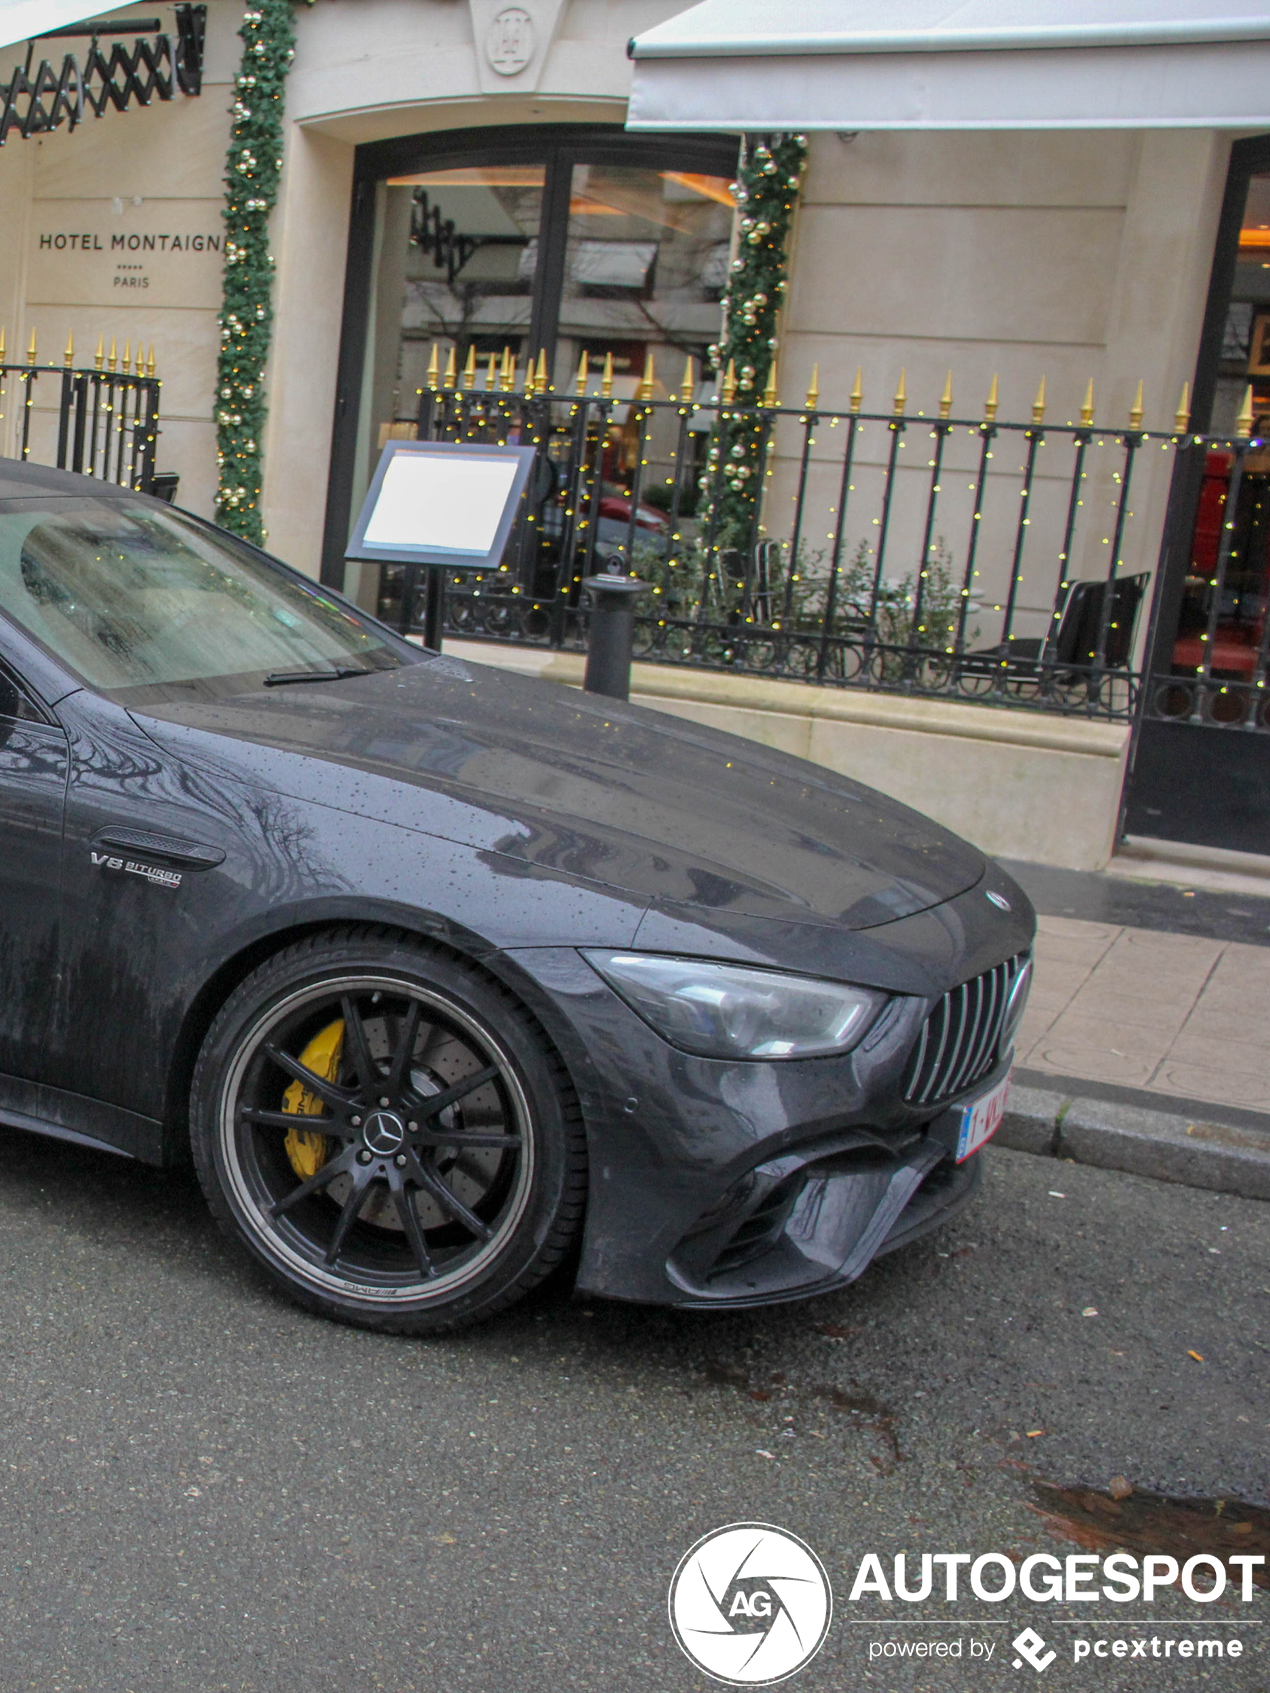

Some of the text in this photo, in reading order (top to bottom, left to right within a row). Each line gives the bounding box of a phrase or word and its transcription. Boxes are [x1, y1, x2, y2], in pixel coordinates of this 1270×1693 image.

[40, 234, 227, 251] HOTEL MONTAIGN
[113, 277, 150, 289] PARIS
[91, 852, 124, 870] V8
[125, 861, 183, 882] BITURBO
